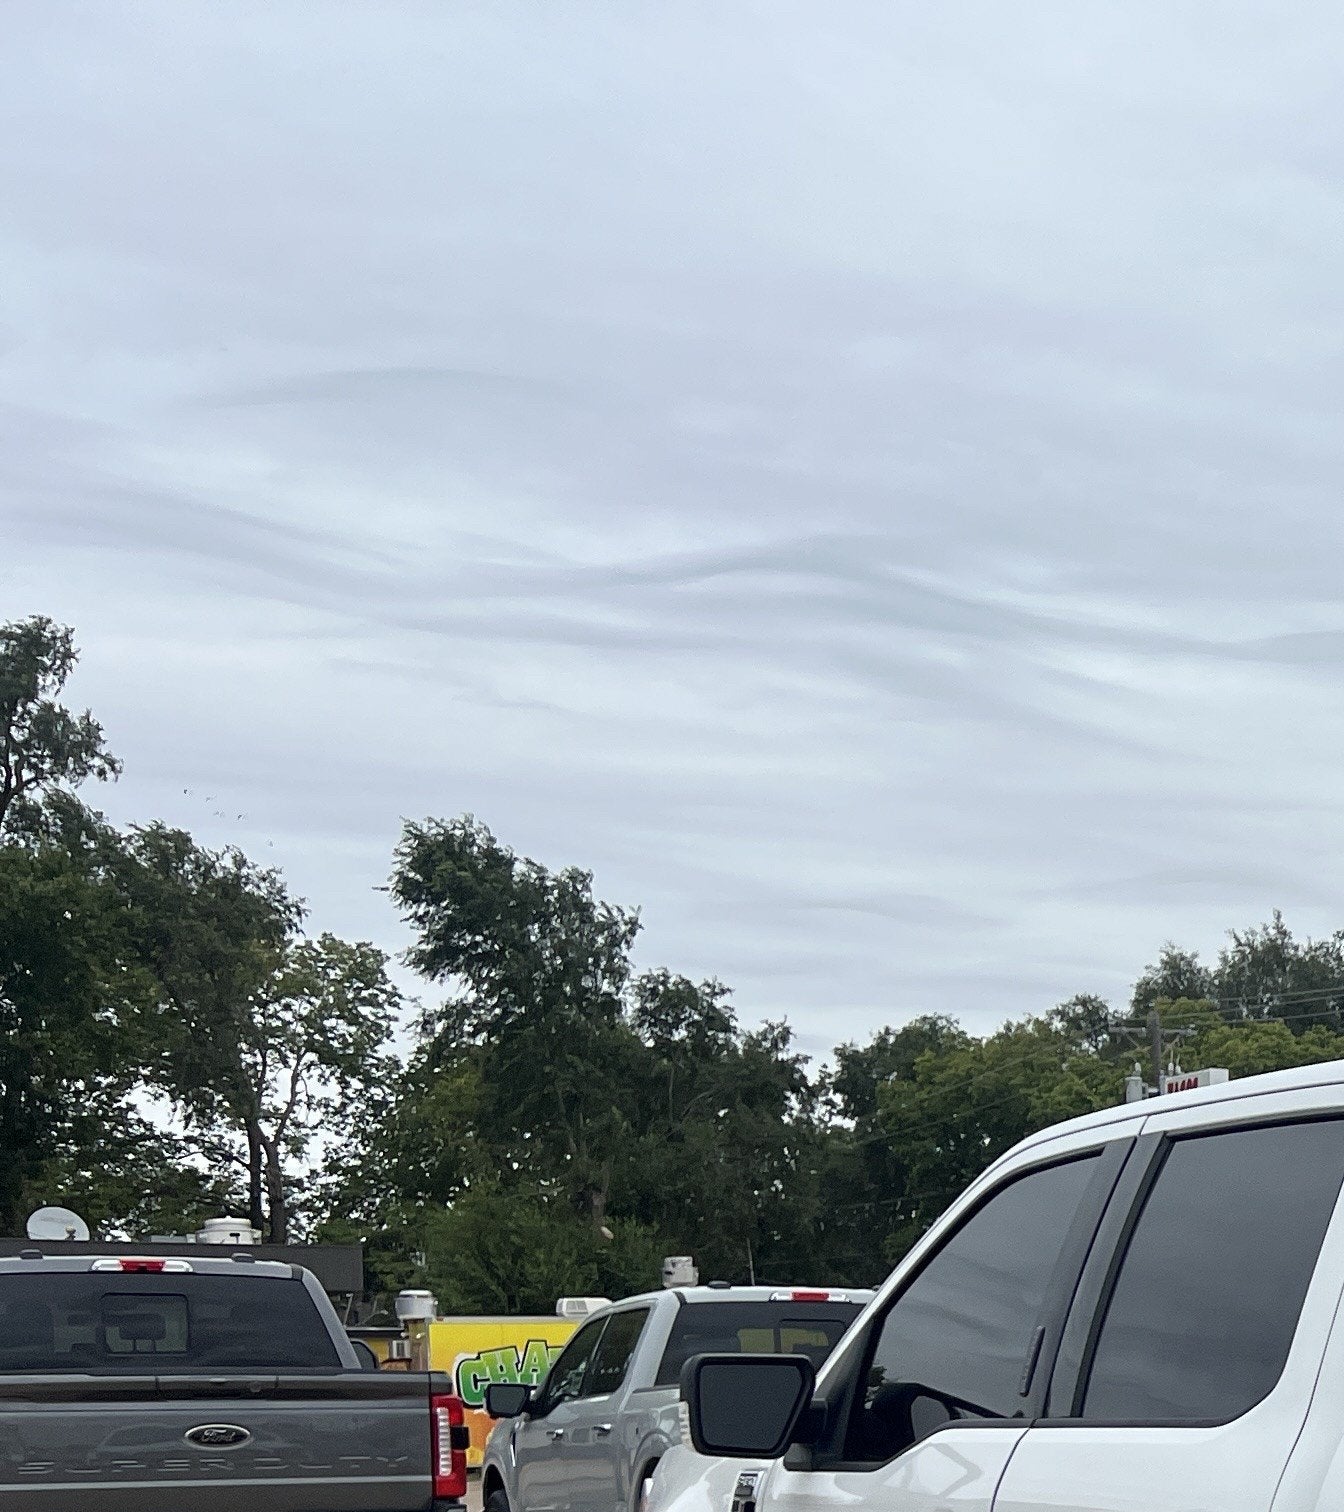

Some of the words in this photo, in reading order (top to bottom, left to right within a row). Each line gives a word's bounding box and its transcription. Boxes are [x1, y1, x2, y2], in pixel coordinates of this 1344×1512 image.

[458, 1339, 565, 1408] CHA
[17, 1458, 235, 1475] SUPER
[252, 1456, 408, 1470] DUTY
